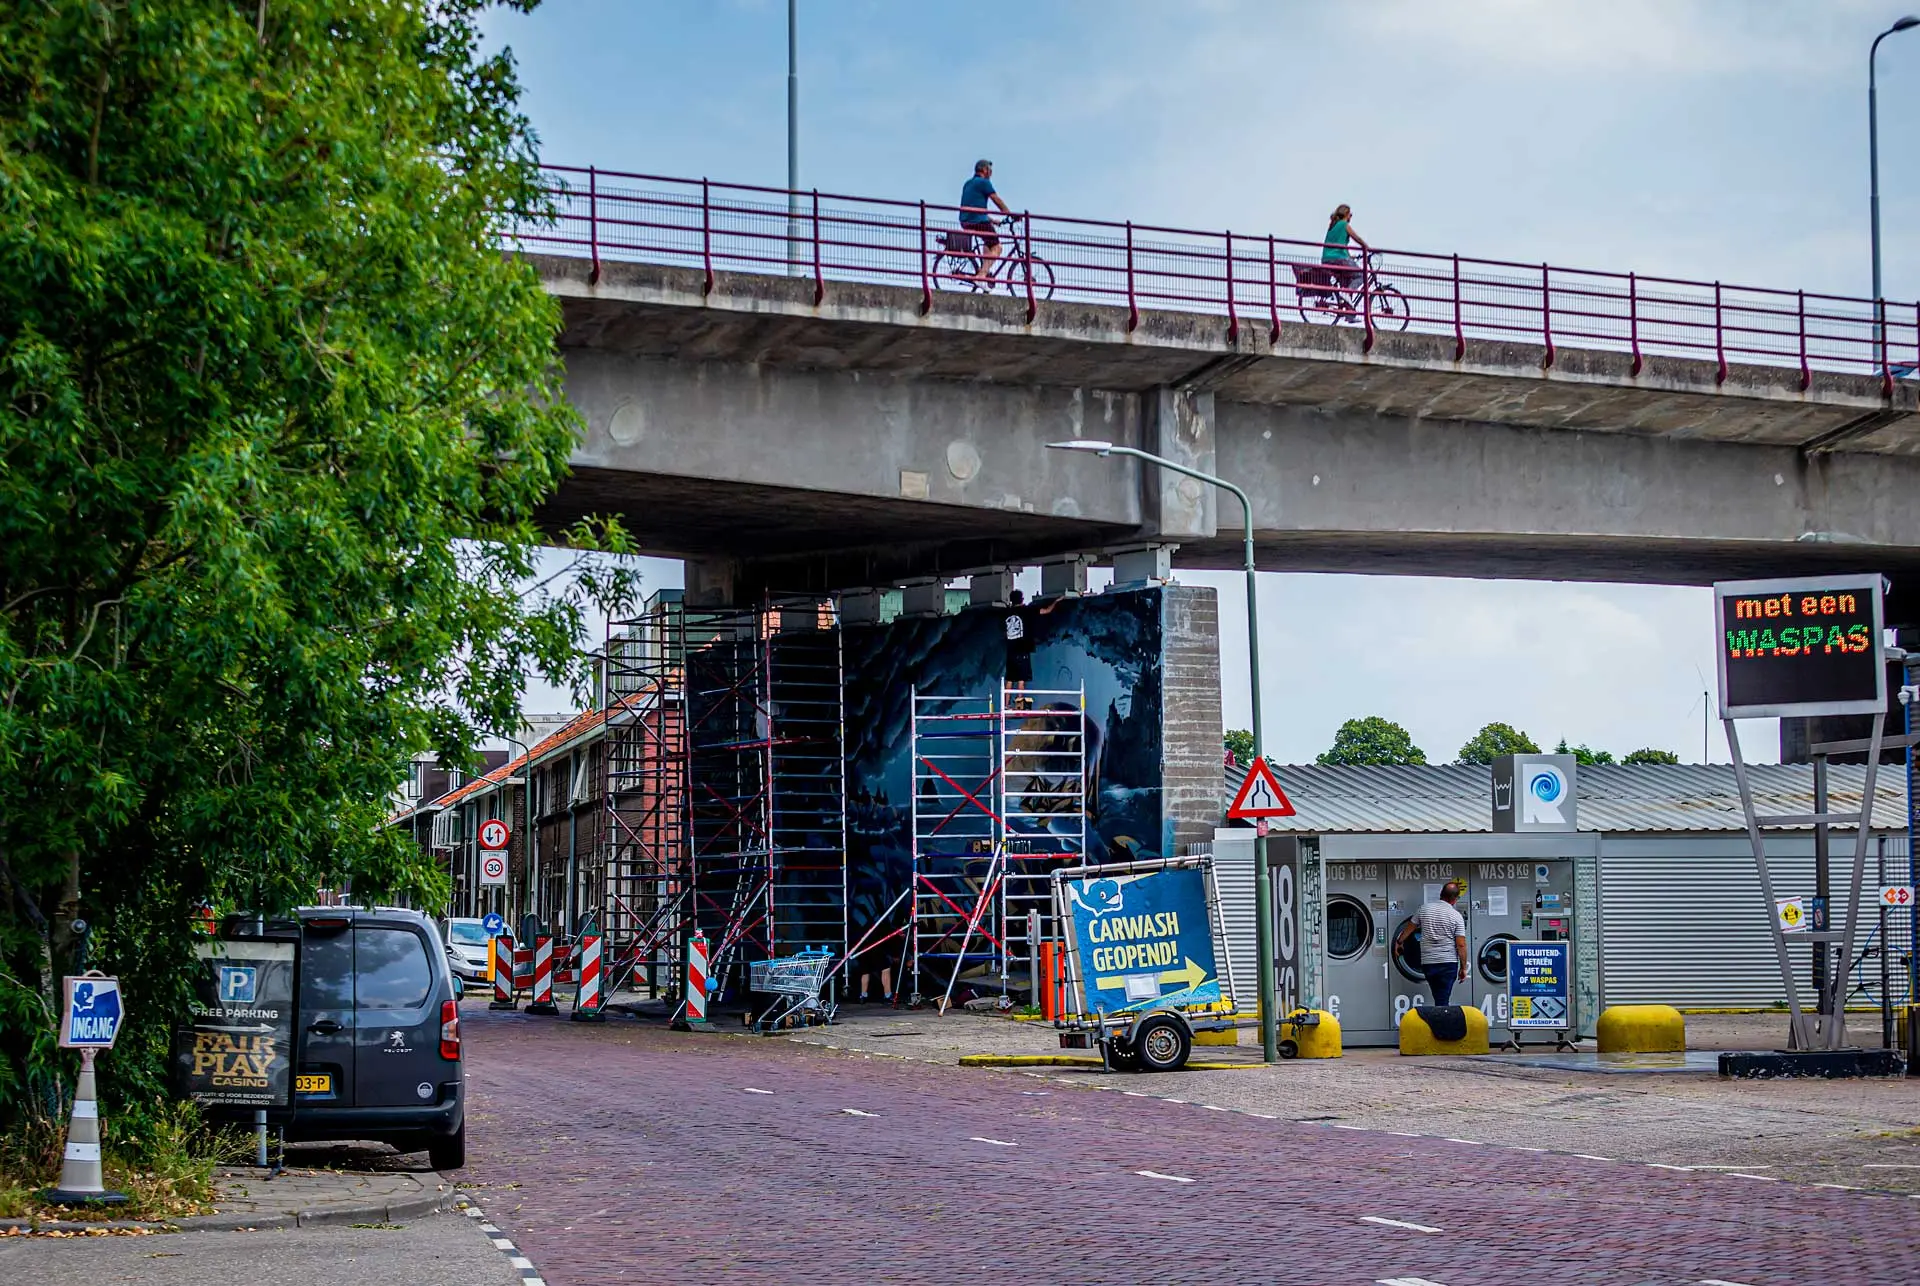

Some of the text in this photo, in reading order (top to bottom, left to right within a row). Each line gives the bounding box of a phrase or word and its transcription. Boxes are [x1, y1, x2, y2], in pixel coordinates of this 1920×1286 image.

[1736, 593, 1856, 618] met een
[1726, 624, 1869, 658] WASPAS
[487, 863, 500, 872] 30
[1350, 864, 1362, 880] 18
[1364, 864, 1377, 877] KG
[1394, 864, 1452, 880] WAS 18 KG
[1479, 864, 1529, 880] WAS 8 KG
[1089, 911, 1180, 943] CARWASH
[1093, 941, 1179, 972] GEOPEND!
[1517, 949, 1559, 957] UITSLUITEND
[1524, 967, 1552, 975] MET PIN
[1519, 976, 1557, 984] OF WASPAS
[194, 1007, 279, 1019] FREE PARKING
[72, 1016, 114, 1039] INGANG
[193, 1033, 276, 1055] FAIR
[192, 1052, 275, 1078] PLAY
[212, 1077, 268, 1088] CASINO
